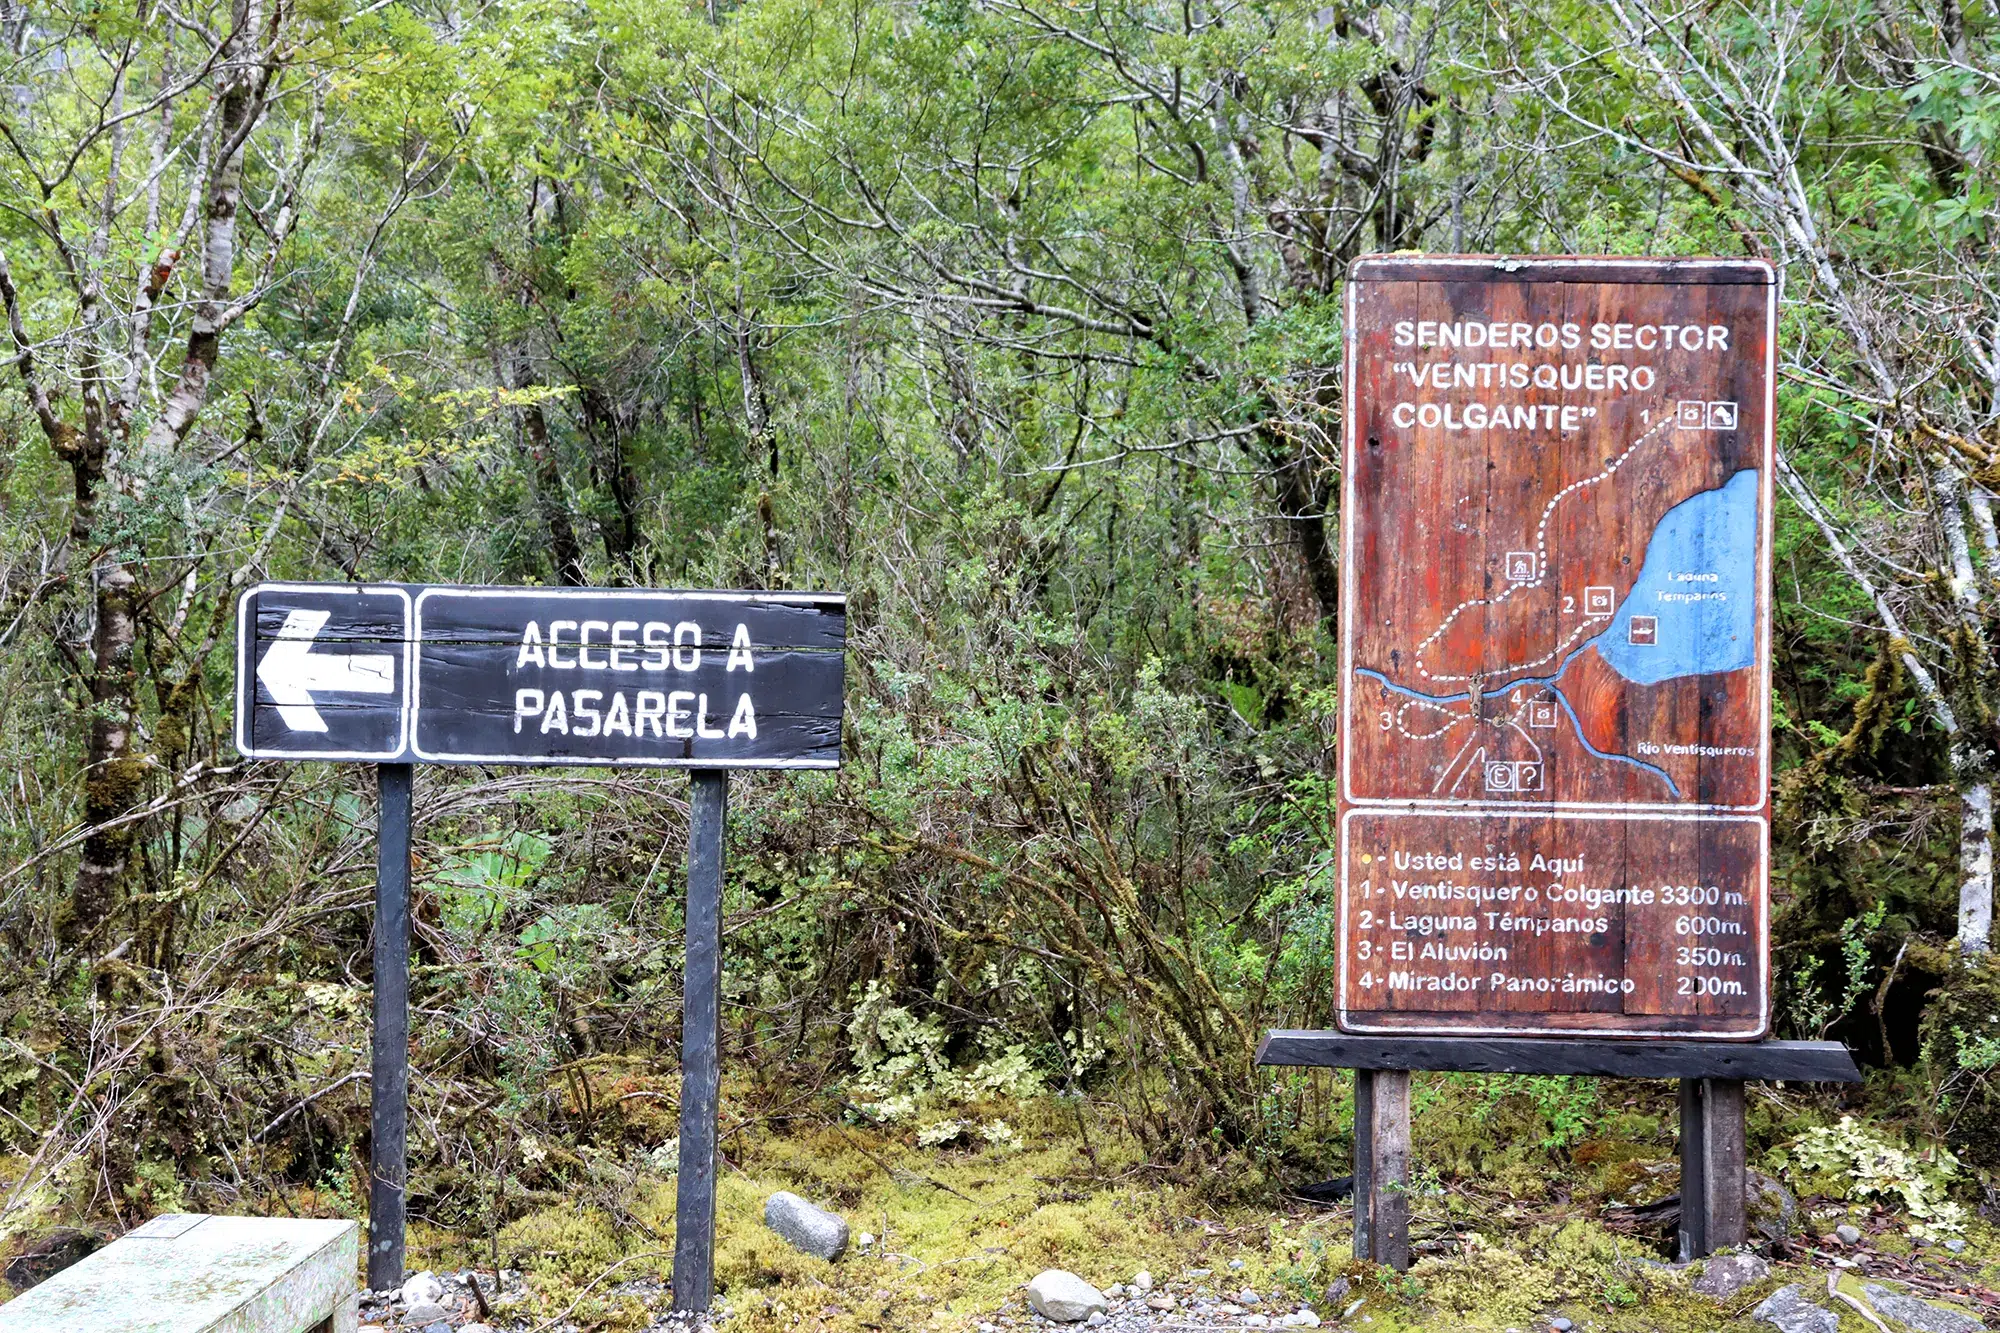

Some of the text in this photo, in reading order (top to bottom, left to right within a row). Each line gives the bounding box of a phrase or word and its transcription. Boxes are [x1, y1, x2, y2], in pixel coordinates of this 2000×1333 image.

[1394, 322, 1729, 351] SENDEROS SECTOR
[1639, 409, 1649, 425] 1
[1562, 596, 1575, 613] 2
[516, 620, 755, 673] ACCESO A
[1511, 689, 1522, 705] 4
[513, 688, 757, 739] PASARELA
[1379, 711, 1393, 731] 3
[1663, 743, 1755, 757] Ventisqueros
[1394, 850, 1463, 871] Usted
[1470, 851, 1521, 872] está
[1529, 852, 1585, 878] Aquí
[1392, 880, 1539, 907] Ventisquero
[1546, 883, 1655, 910] Colgante
[1390, 910, 1477, 936] Laguna
[1483, 912, 1609, 937] Témpanos
[1391, 941, 1414, 962] El
[1420, 941, 1508, 961] Aluvión
[1388, 970, 1482, 992] Mirador
[1490, 972, 1635, 994] Panorámico
